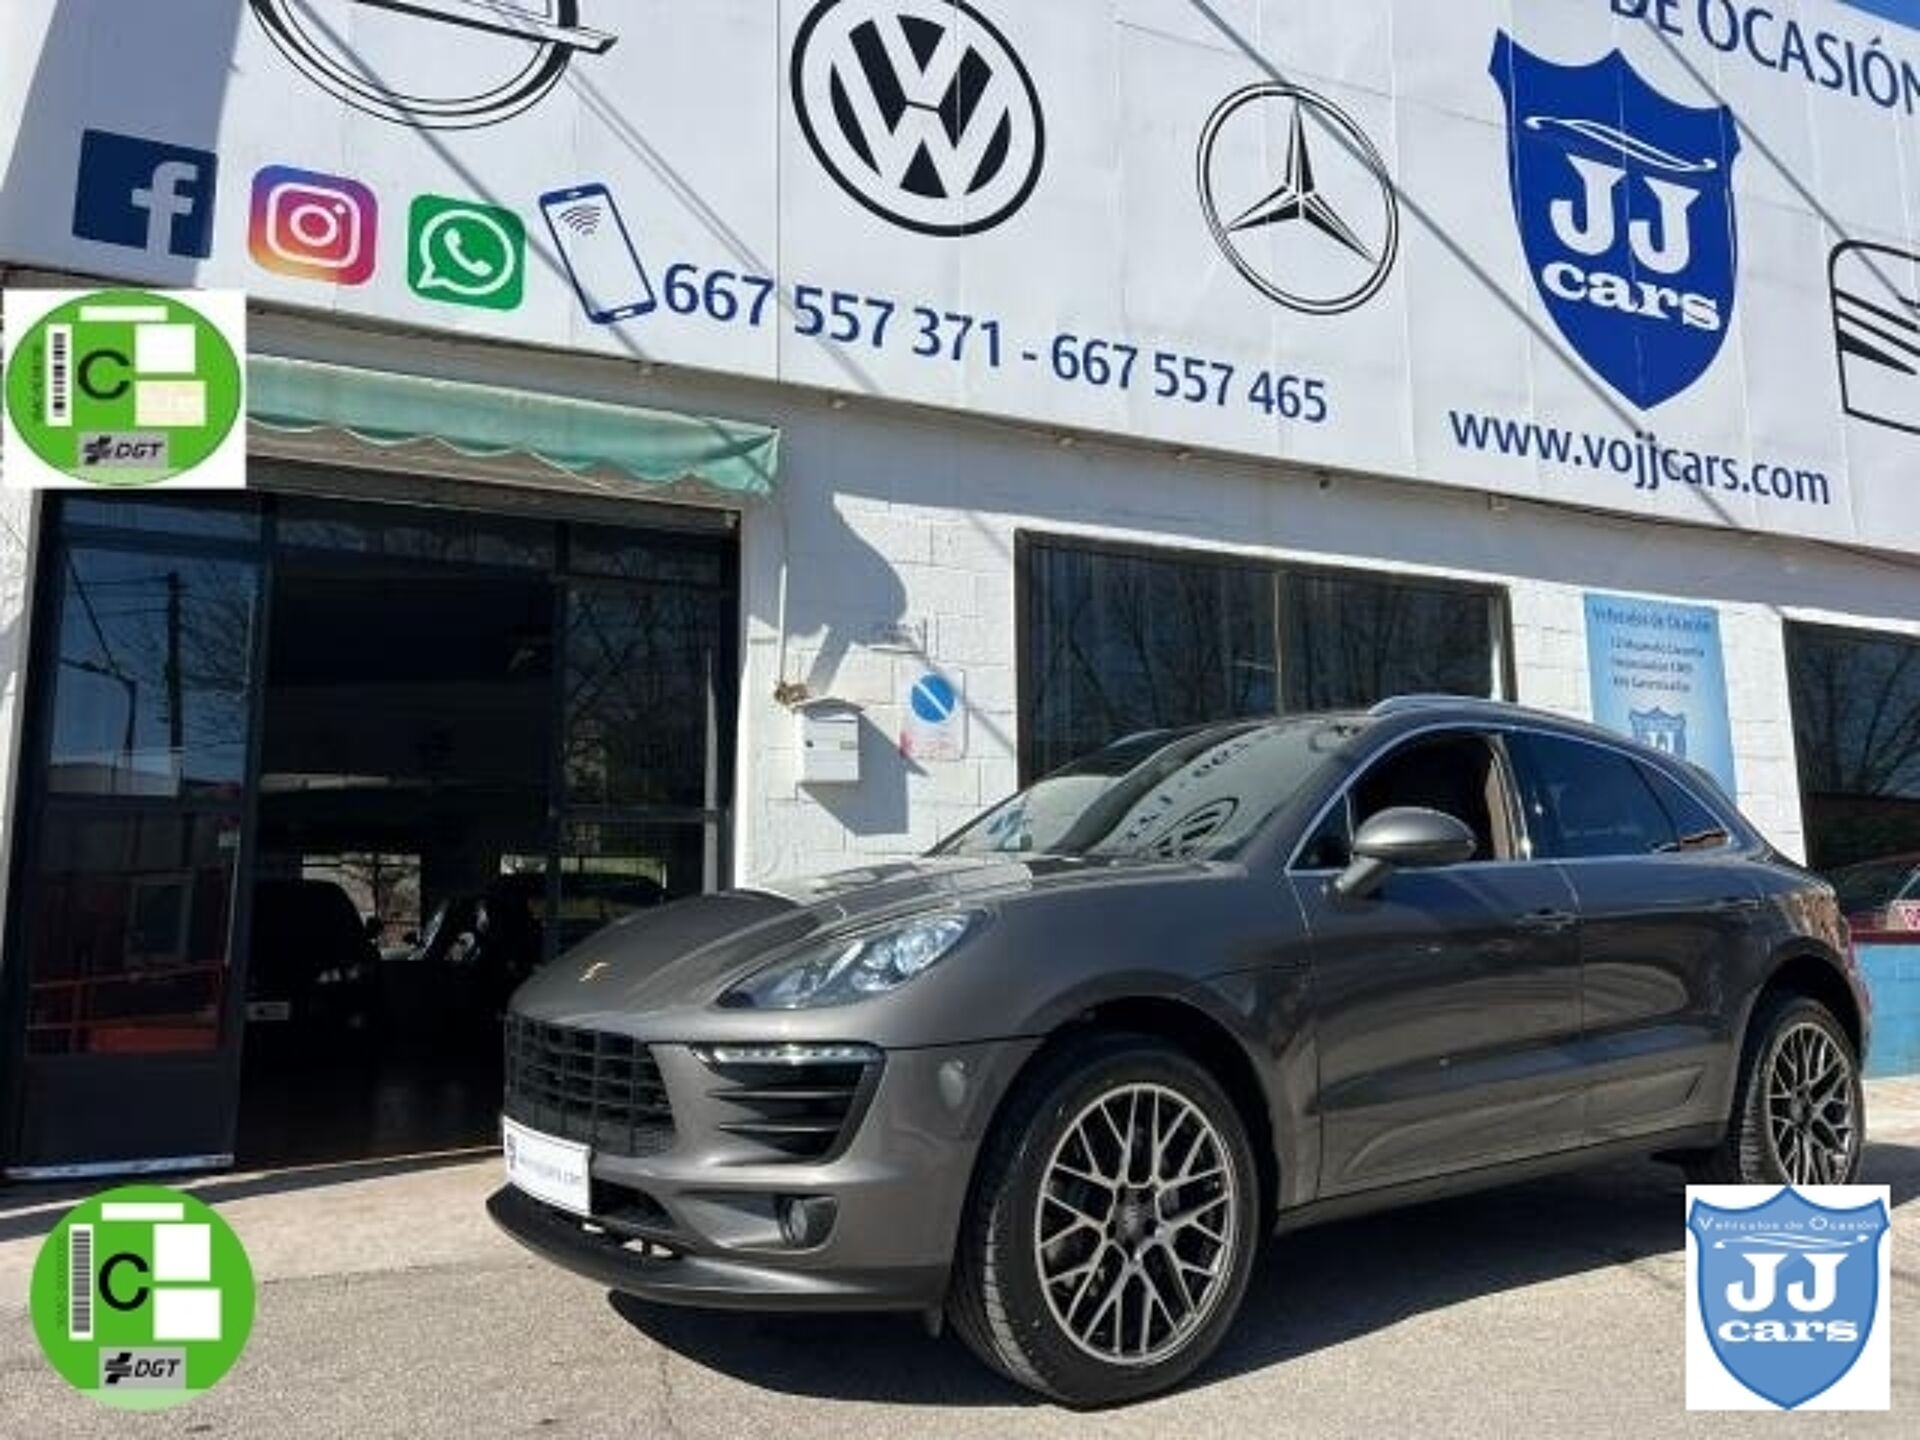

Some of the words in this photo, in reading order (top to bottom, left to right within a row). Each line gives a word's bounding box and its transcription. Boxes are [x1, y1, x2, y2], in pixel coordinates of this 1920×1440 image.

[1550, 153, 1701, 274] JJ
[663, 263, 774, 327] 667
[794, 285, 895, 348] 557
[911, 307, 1000, 368] 371
[1051, 333, 1138, 390] 667
[1153, 351, 1235, 406] 557
[1247, 371, 1328, 423] 465
[1542, 262, 1720, 331] cars
[1449, 401, 1830, 506] www.vojjcars.com
